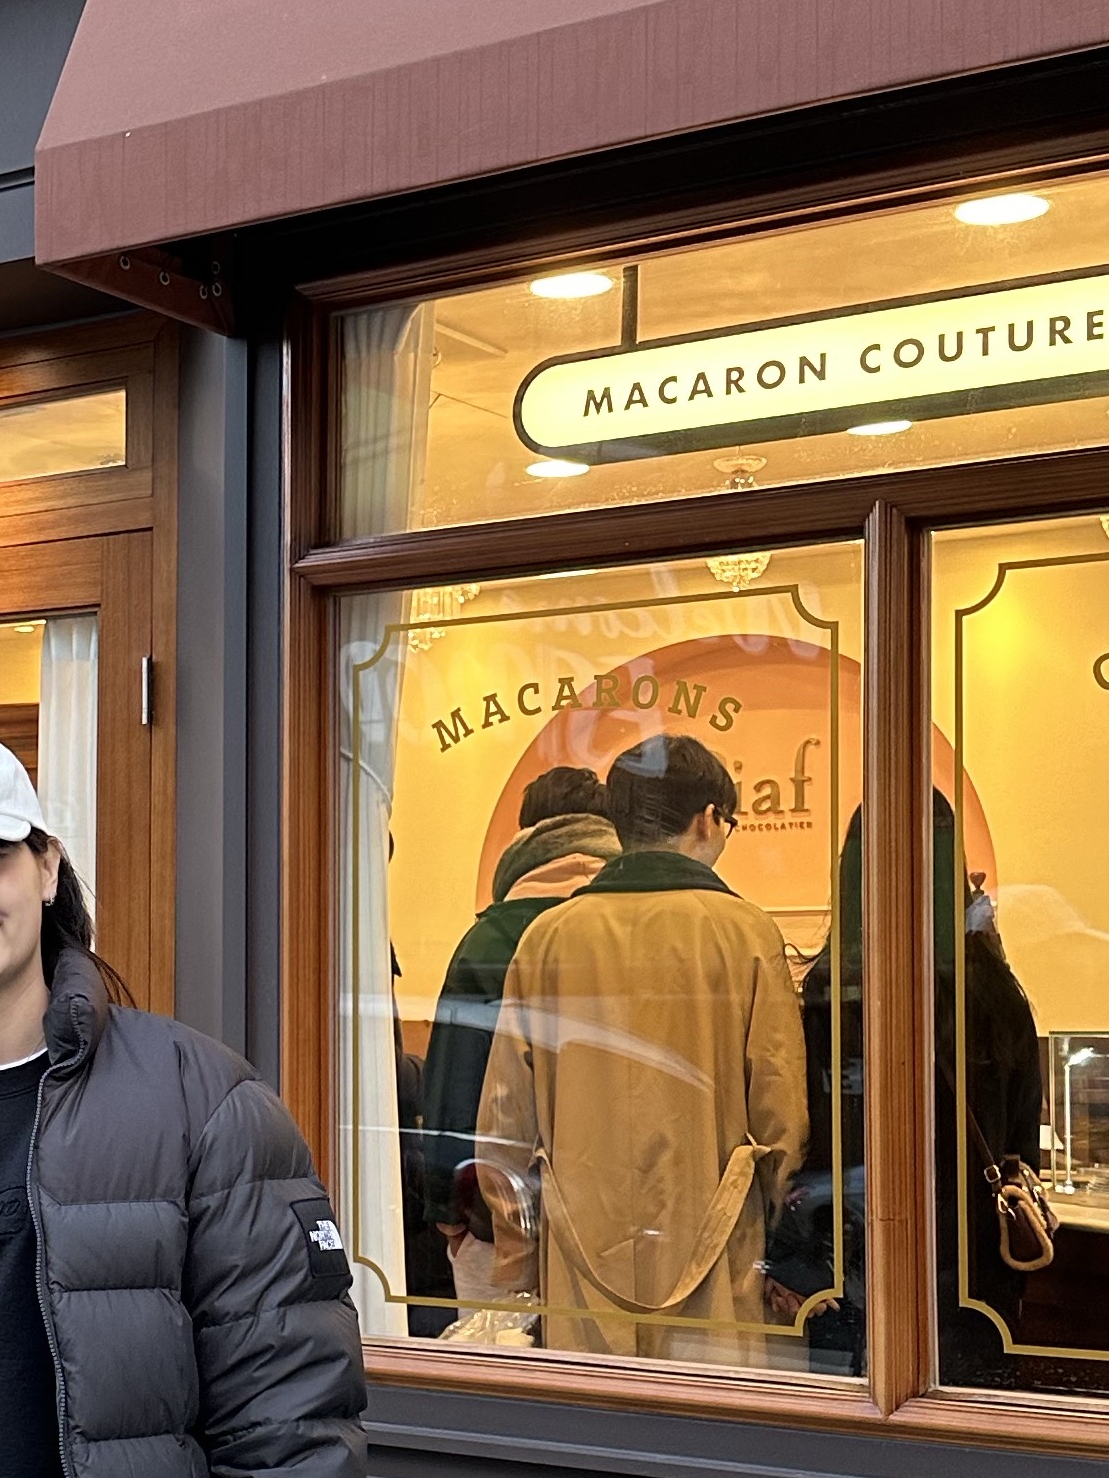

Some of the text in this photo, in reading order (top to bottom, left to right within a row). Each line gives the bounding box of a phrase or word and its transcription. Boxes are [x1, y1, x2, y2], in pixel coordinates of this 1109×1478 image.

[583, 309, 1105, 417] MACARON COUTURE
[431, 674, 743, 753] MACARONS
[715, 738, 821, 815] iaf
